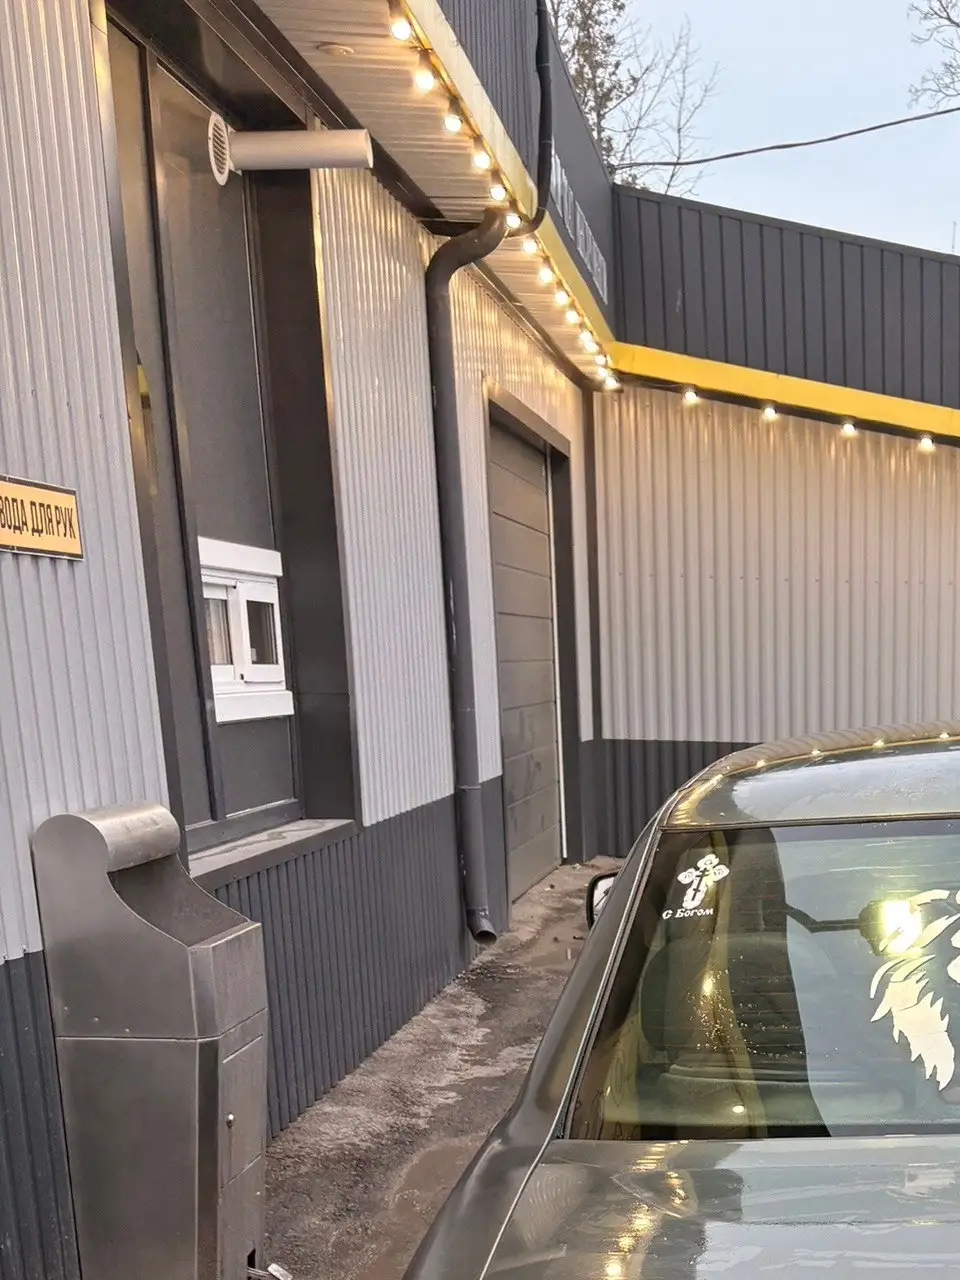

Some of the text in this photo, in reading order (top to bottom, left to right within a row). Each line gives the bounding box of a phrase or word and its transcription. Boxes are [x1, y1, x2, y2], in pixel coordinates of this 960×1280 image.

[0, 496, 76, 539] ВОДА ДЛЯ РУК
[662, 908, 714, 920] С Богом
